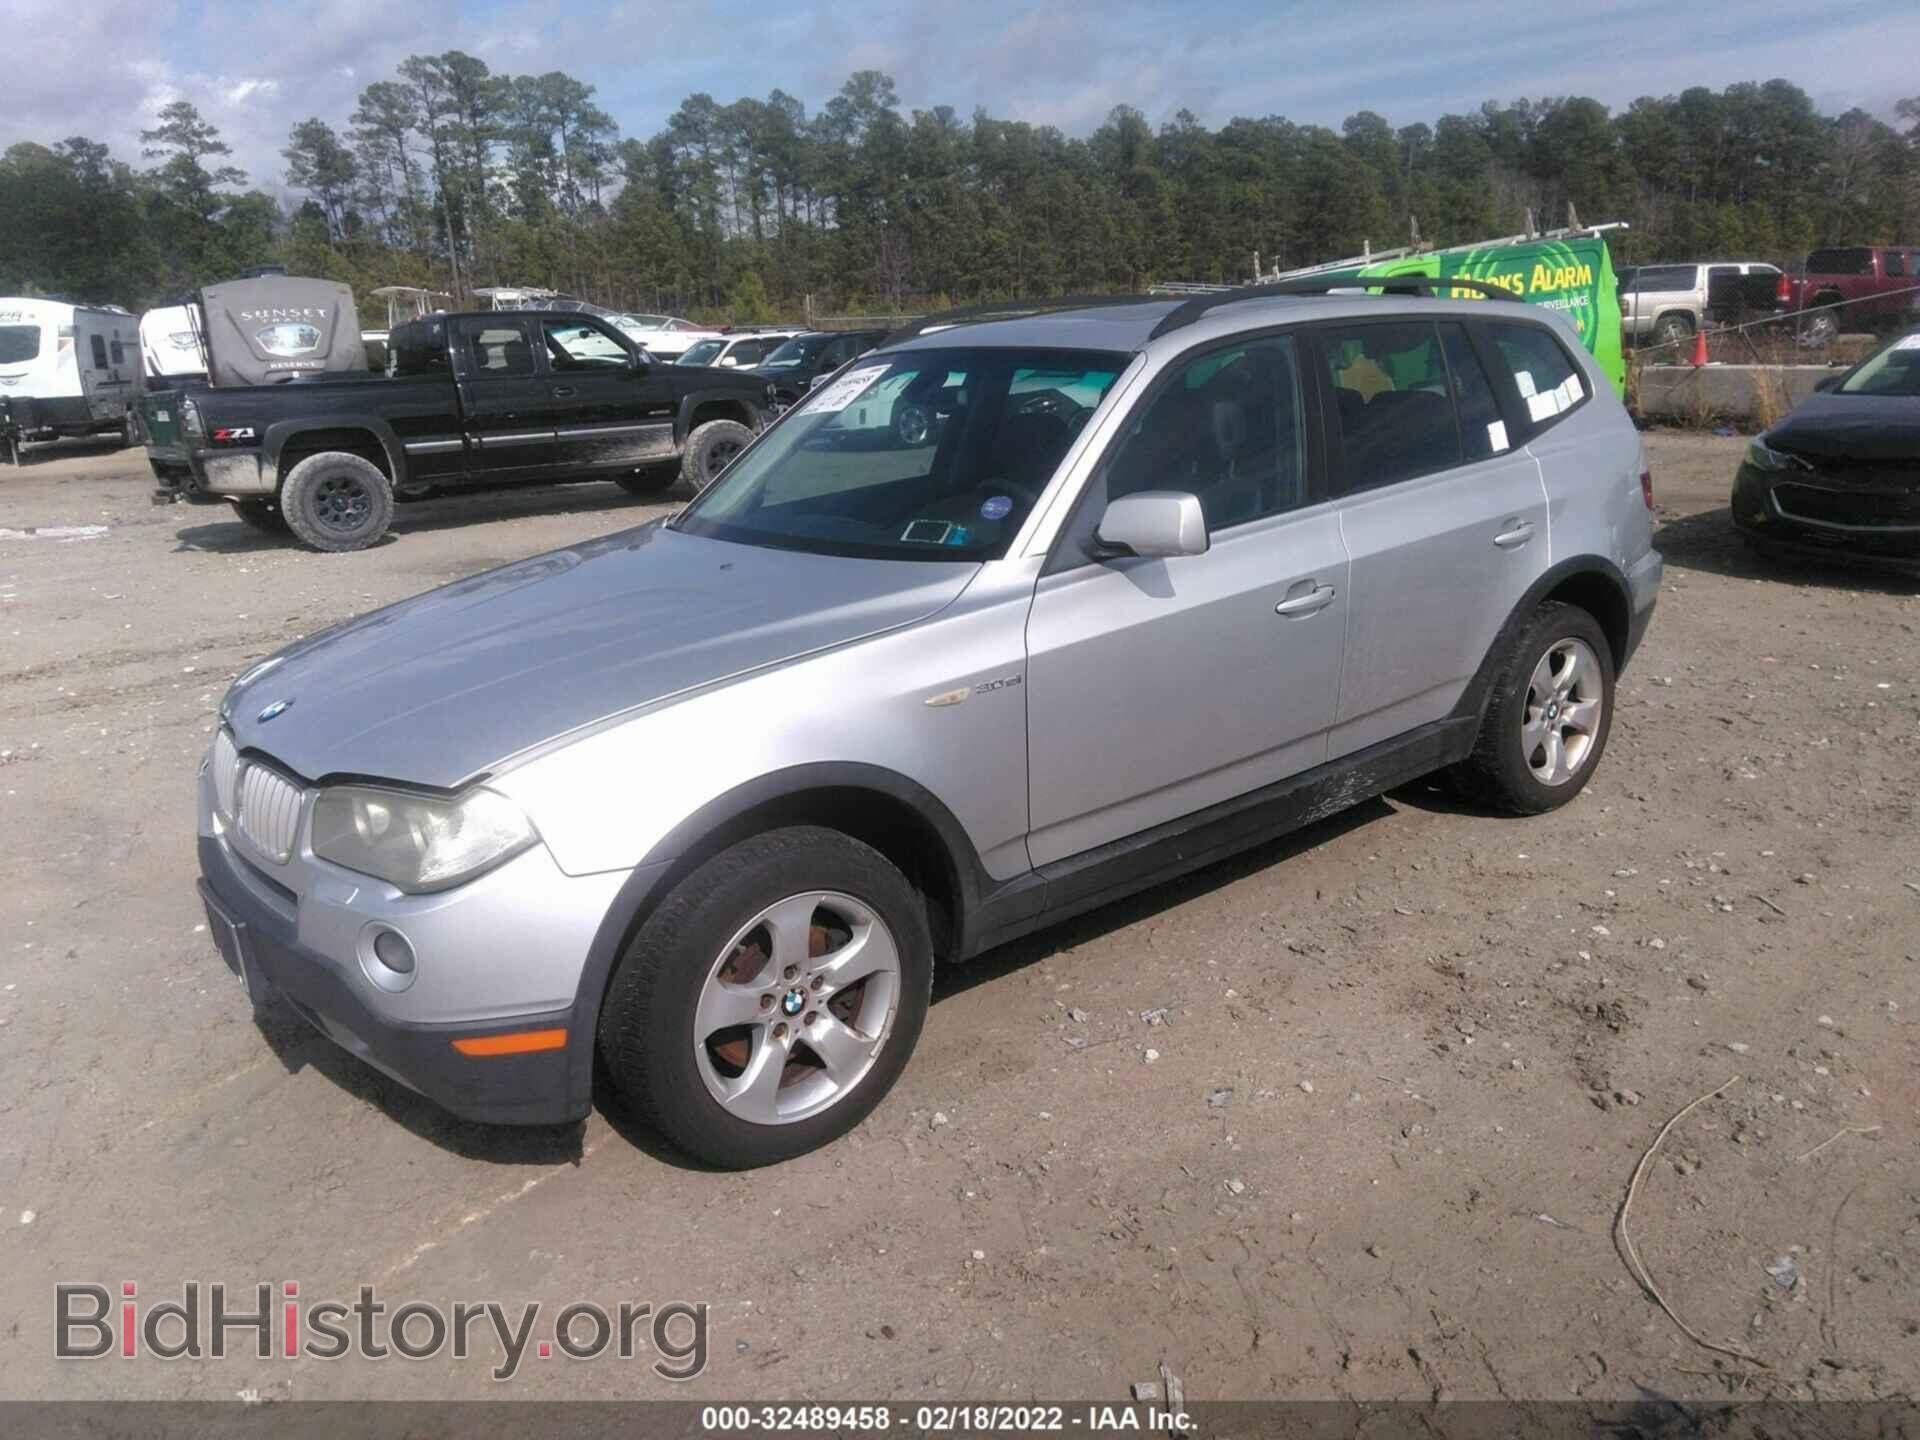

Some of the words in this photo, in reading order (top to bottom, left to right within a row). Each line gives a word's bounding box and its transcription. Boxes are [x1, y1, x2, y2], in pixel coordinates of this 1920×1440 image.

[1529, 263, 1592, 293] ALARM
[1536, 295, 1589, 310] RVEILLANCE
[240, 308, 328, 321] SUNSET
[214, 426, 255, 440] Z71
